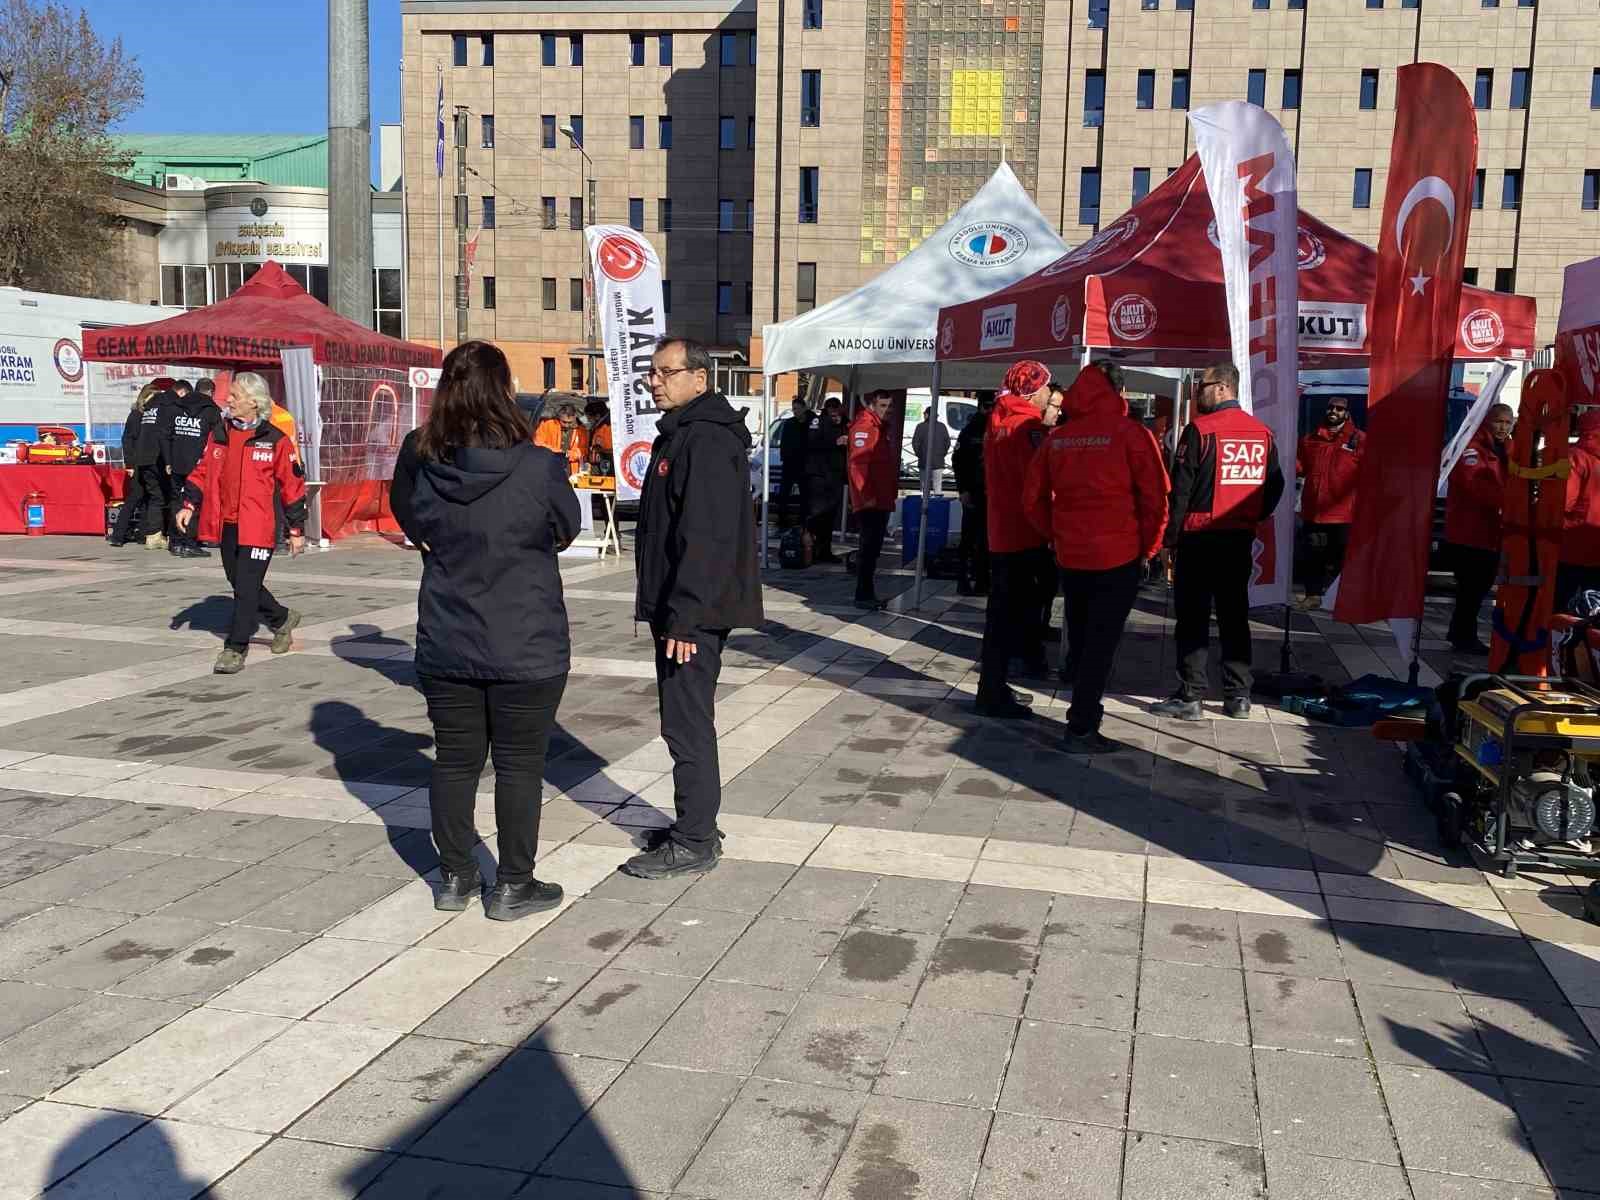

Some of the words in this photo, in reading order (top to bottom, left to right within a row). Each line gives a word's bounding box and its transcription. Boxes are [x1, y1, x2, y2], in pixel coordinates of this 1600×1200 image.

[985, 318, 1012, 337] AKUT
[96, 336, 139, 357] GEAK
[144, 334, 200, 357] ARAMA
[828, 338, 884, 350] ANADOLU
[1, 368, 35, 382] ARACI
[1222, 444, 1265, 463] SAR
[1221, 465, 1264, 479] TEAM
